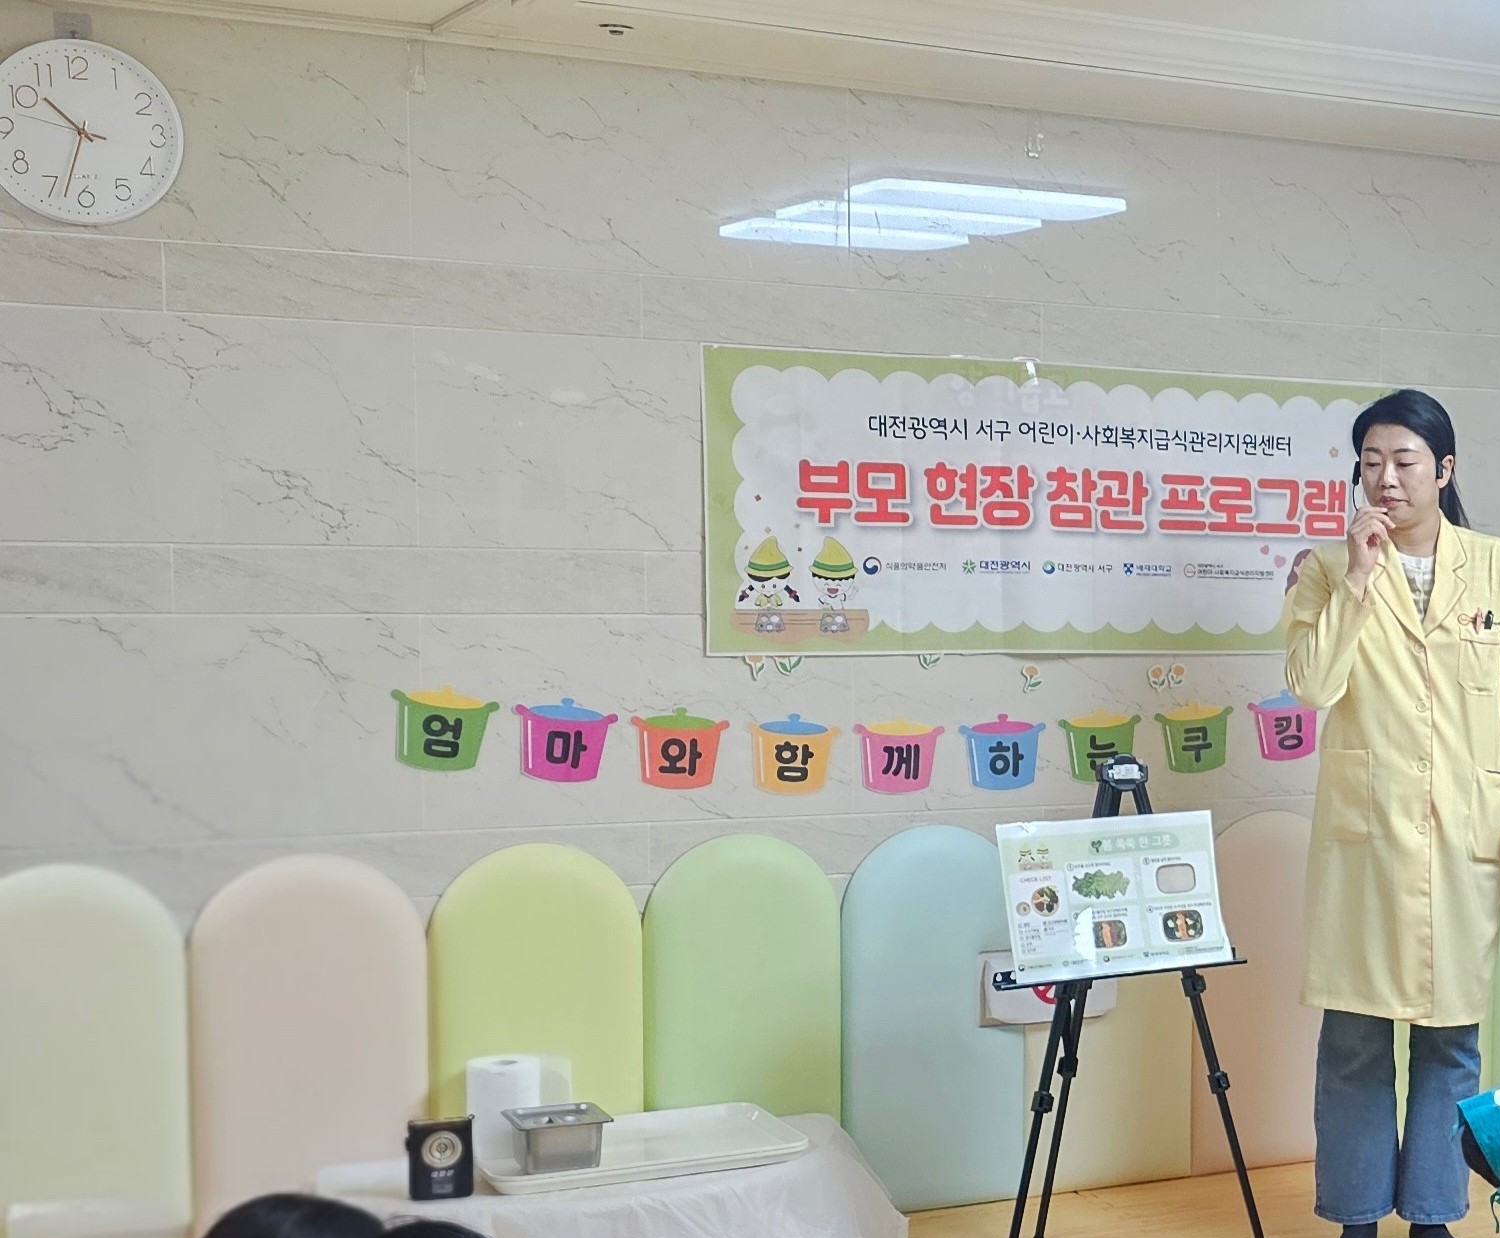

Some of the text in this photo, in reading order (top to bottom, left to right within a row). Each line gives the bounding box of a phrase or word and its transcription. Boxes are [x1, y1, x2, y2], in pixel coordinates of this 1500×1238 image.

[33, 62, 53, 88] 11
[64, 55, 89, 81] 12
[111, 67, 118, 91] 1
[8, 84, 39, 109] 10
[134, 91, 153, 116] 2
[0, 116, 15, 140] 9
[149, 123, 167, 149] 3
[12, 149, 30, 175] 8
[139, 156, 156, 177] 4
[41, 175, 59, 199] 7
[77, 184, 96, 209] 6
[115, 177, 133, 202] 5
[868, 414, 1292, 457] 대전광역시 서구 어린이·사회복지급식관리지원센터
[796, 458, 1347, 537] 부모 현장 참관 프로그램
[886, 561, 947, 572] 식품의약품안전처
[979, 559, 1031, 571] 대전광역시
[1057, 562, 1113, 574] 대전광역시 서구
[1019, 876, 1038, 884] CHECK
